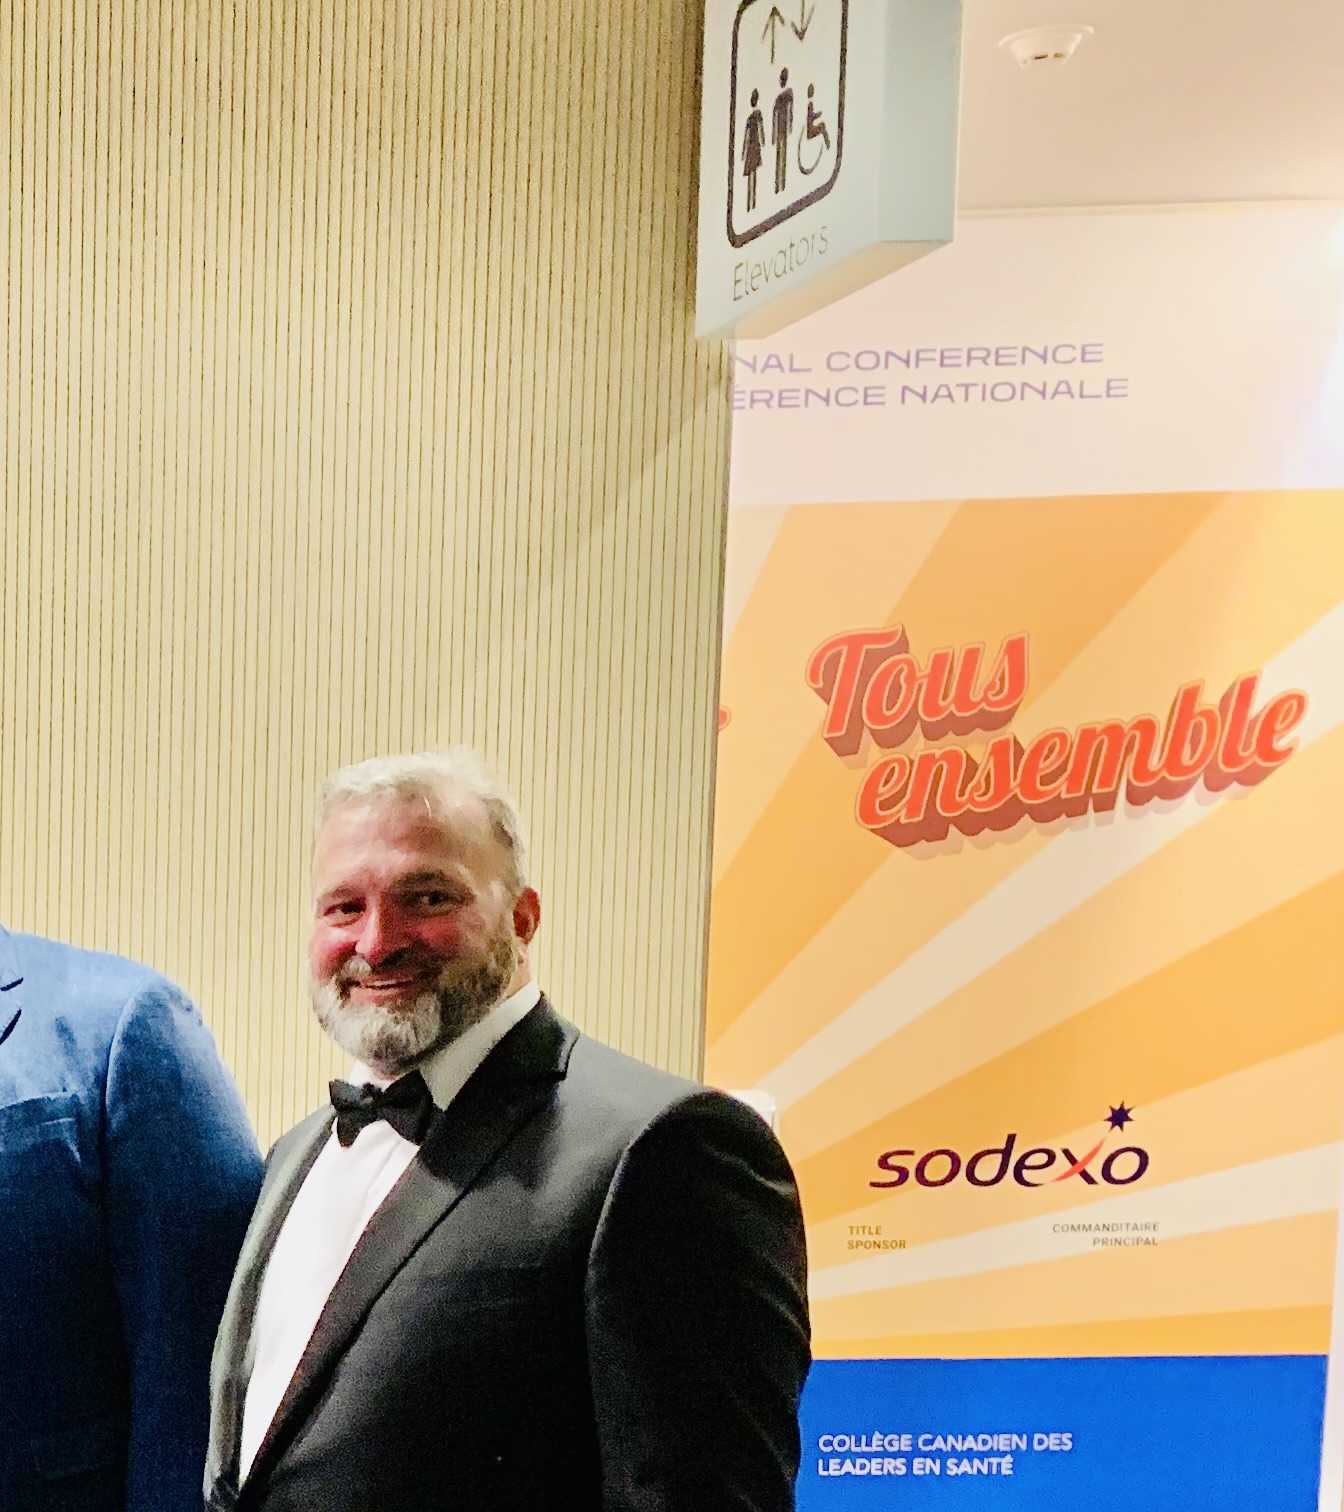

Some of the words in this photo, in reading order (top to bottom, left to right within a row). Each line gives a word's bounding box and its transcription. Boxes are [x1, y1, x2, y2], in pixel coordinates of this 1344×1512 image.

[733, 225, 829, 302] Elevators
[825, 343, 1104, 372] CONFERENCE
[900, 377, 1130, 405] NATIONALE
[806, 622, 1030, 756] Tous
[856, 670, 1309, 847] ensemble
[869, 1132, 1150, 1188] sodexo
[848, 1225, 882, 1236] TITLE
[1052, 1221, 1160, 1234] COMMANDITAIRE
[847, 1239, 907, 1250] SPONSOR
[1092, 1236, 1159, 1247] PRINCIPAL
[818, 1431, 913, 1452] COLLÈGE
[917, 1432, 1027, 1452] CANADIEN
[1032, 1432, 1073, 1451] DES
[817, 1457, 907, 1476] LEADERS
[912, 1457, 940, 1475] EN
[946, 1454, 1014, 1476] SANTÉ
